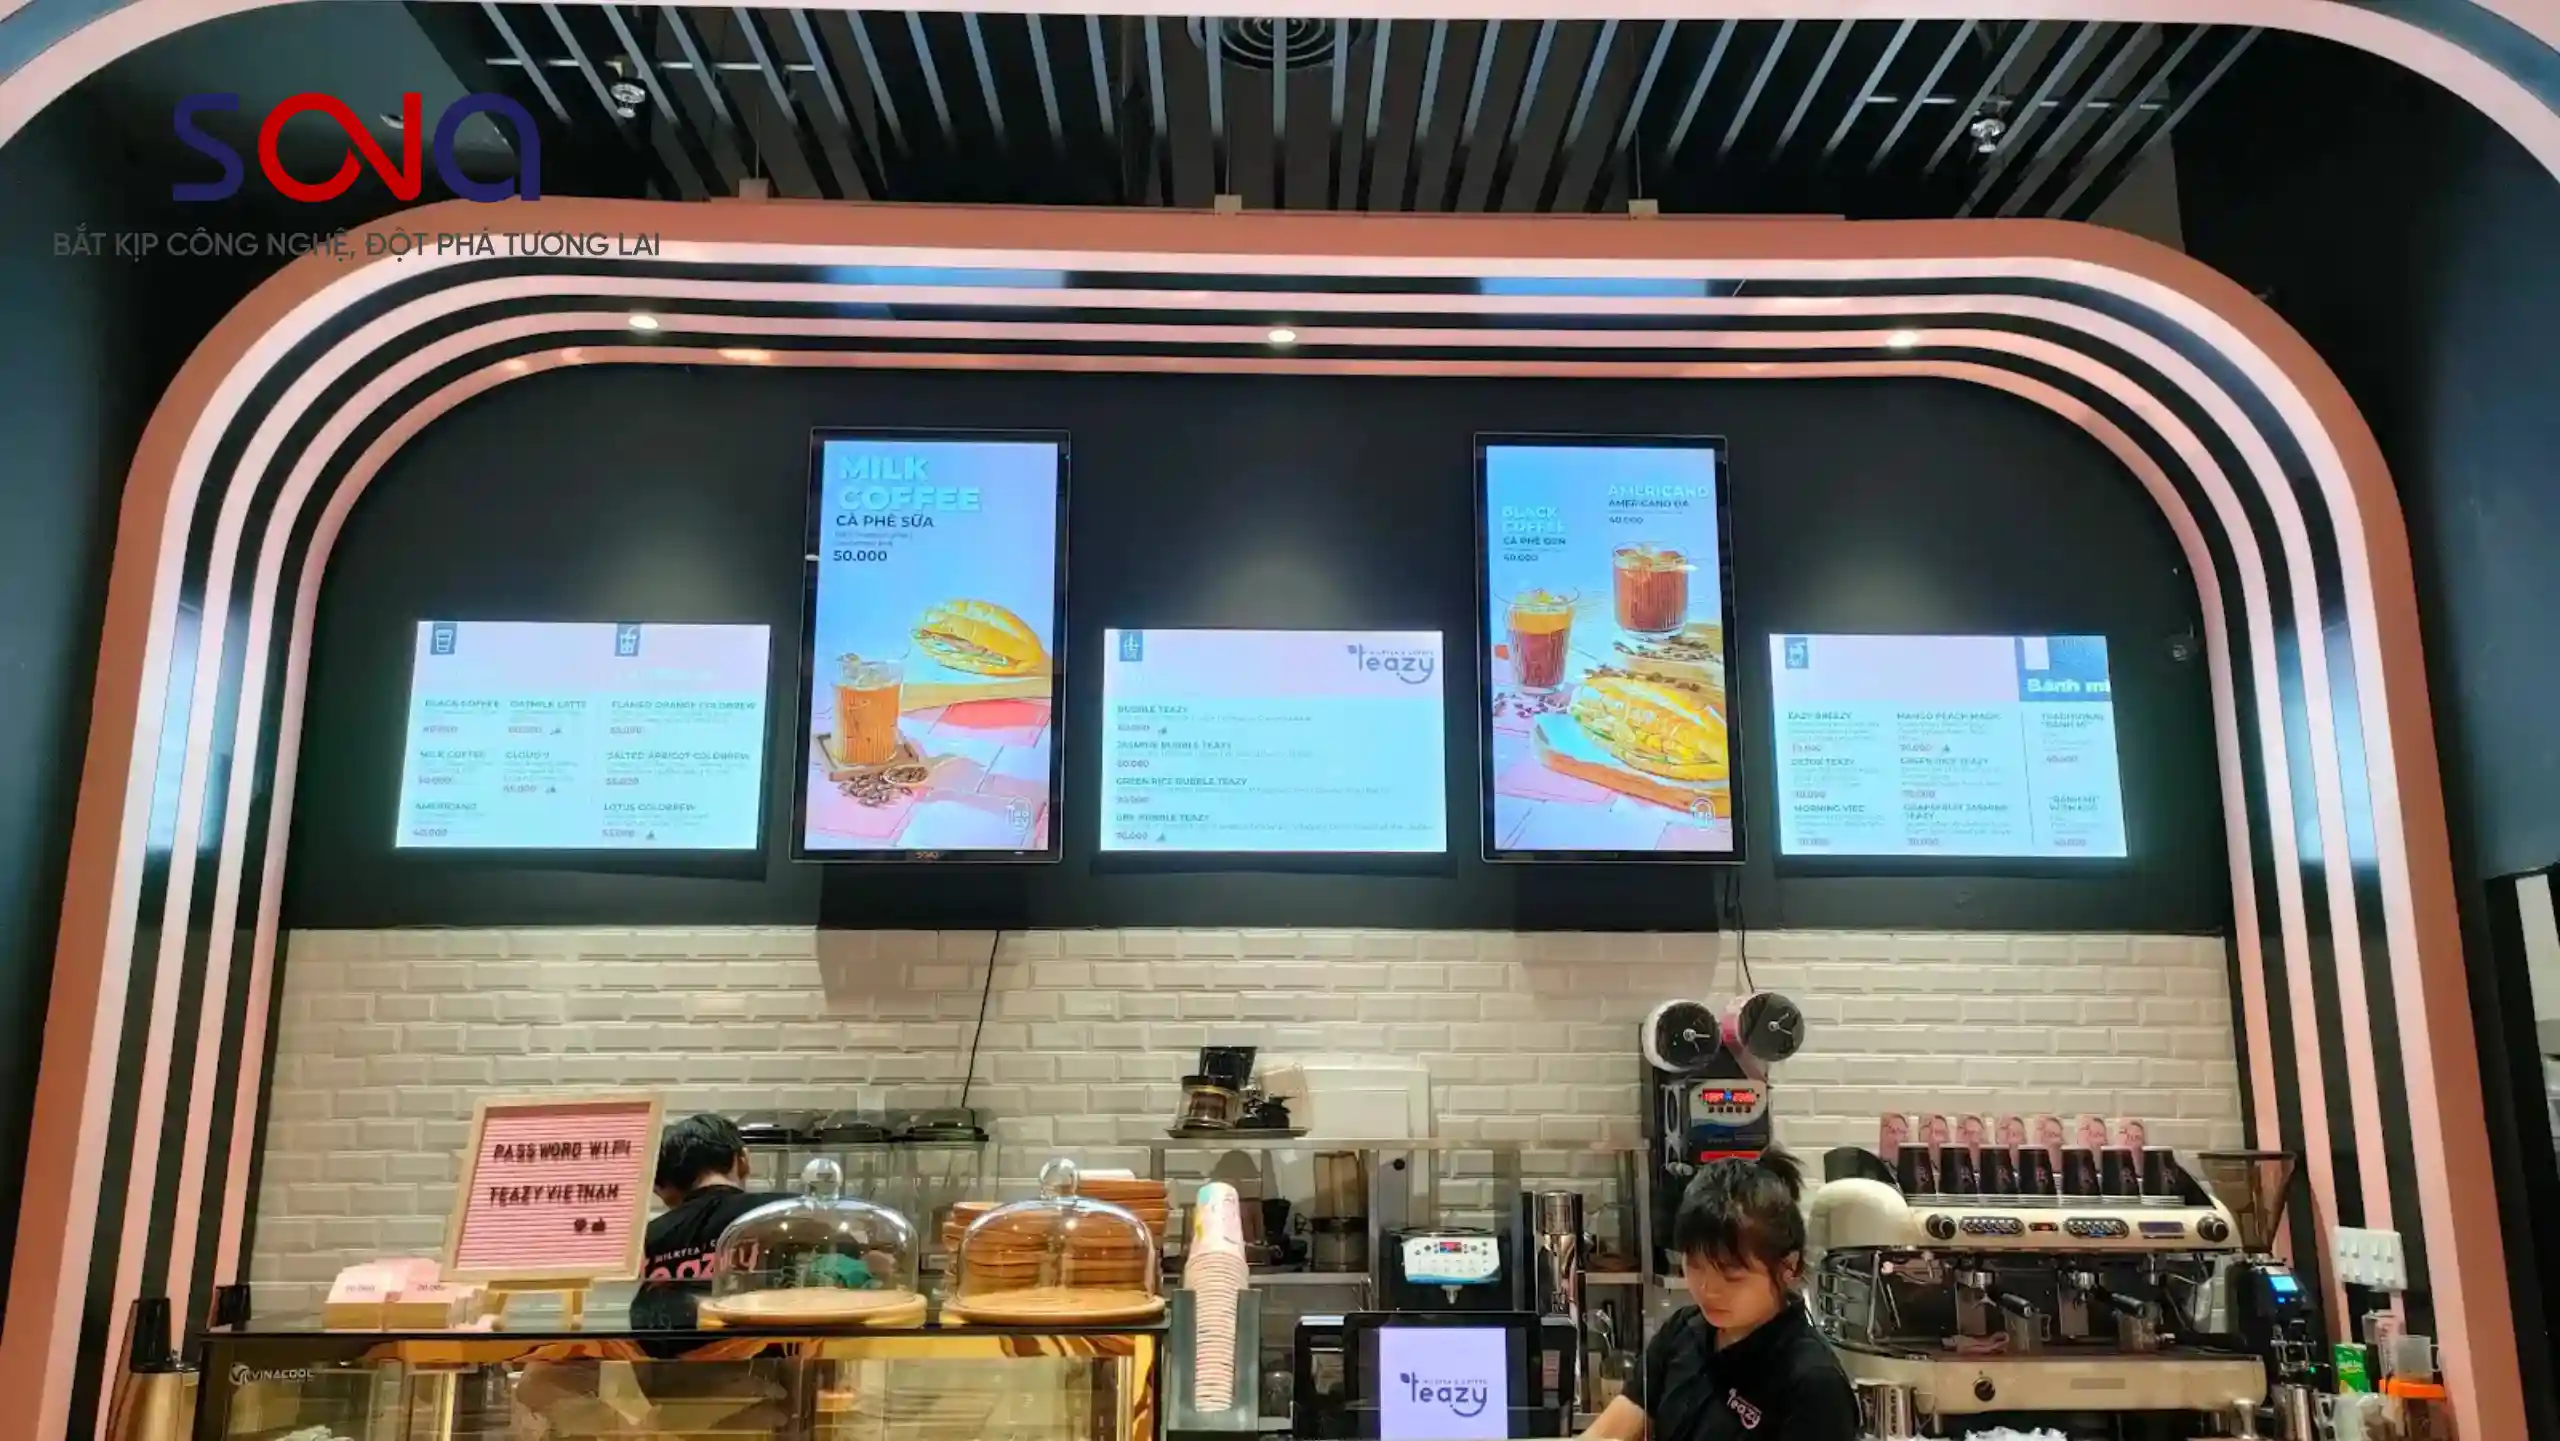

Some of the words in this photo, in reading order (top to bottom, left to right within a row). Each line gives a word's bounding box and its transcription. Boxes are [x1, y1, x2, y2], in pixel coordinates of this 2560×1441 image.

[840, 455, 929, 481] MILK
[839, 484, 981, 512] COFFEE
[1607, 485, 1709, 498] AMERICANO
[836, 513, 859, 527] CÀ
[863, 513, 897, 528] PHÊ
[901, 513, 934, 528] SỮA
[1501, 505, 1560, 519] BLACK
[833, 550, 887, 562] 50.000
[1358, 643, 1434, 685] teazy
[489, 1185, 543, 1207] TEAZY
[252, 1368, 314, 1380] VINACOOL
[1411, 1371, 1488, 1417] teazy
